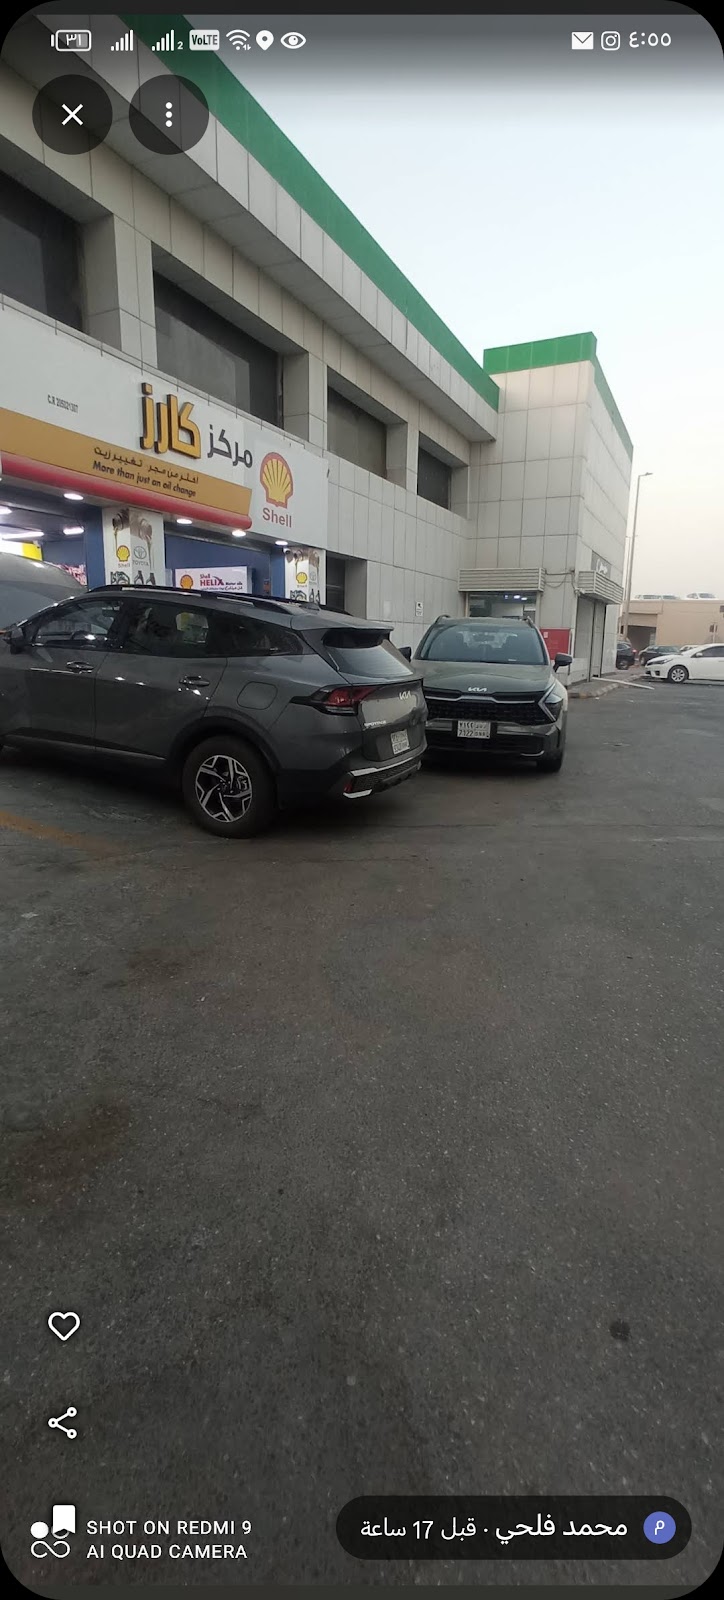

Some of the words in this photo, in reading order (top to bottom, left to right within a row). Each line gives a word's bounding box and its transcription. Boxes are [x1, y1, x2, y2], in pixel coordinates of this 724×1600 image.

[139, 382, 201, 459] كارز
[94, 446, 111, 460] زيت
[207, 424, 253, 468] مركز
[93, 460, 115, 475] More
[117, 467, 135, 480] than
[136, 472, 150, 484] just
[151, 479, 161, 487] an
[162, 481, 171, 490] oil
[173, 483, 196, 498] change
[167, 469, 178, 478] من
[262, 507, 292, 528] Shell
[200, 577, 224, 586] HELIX
